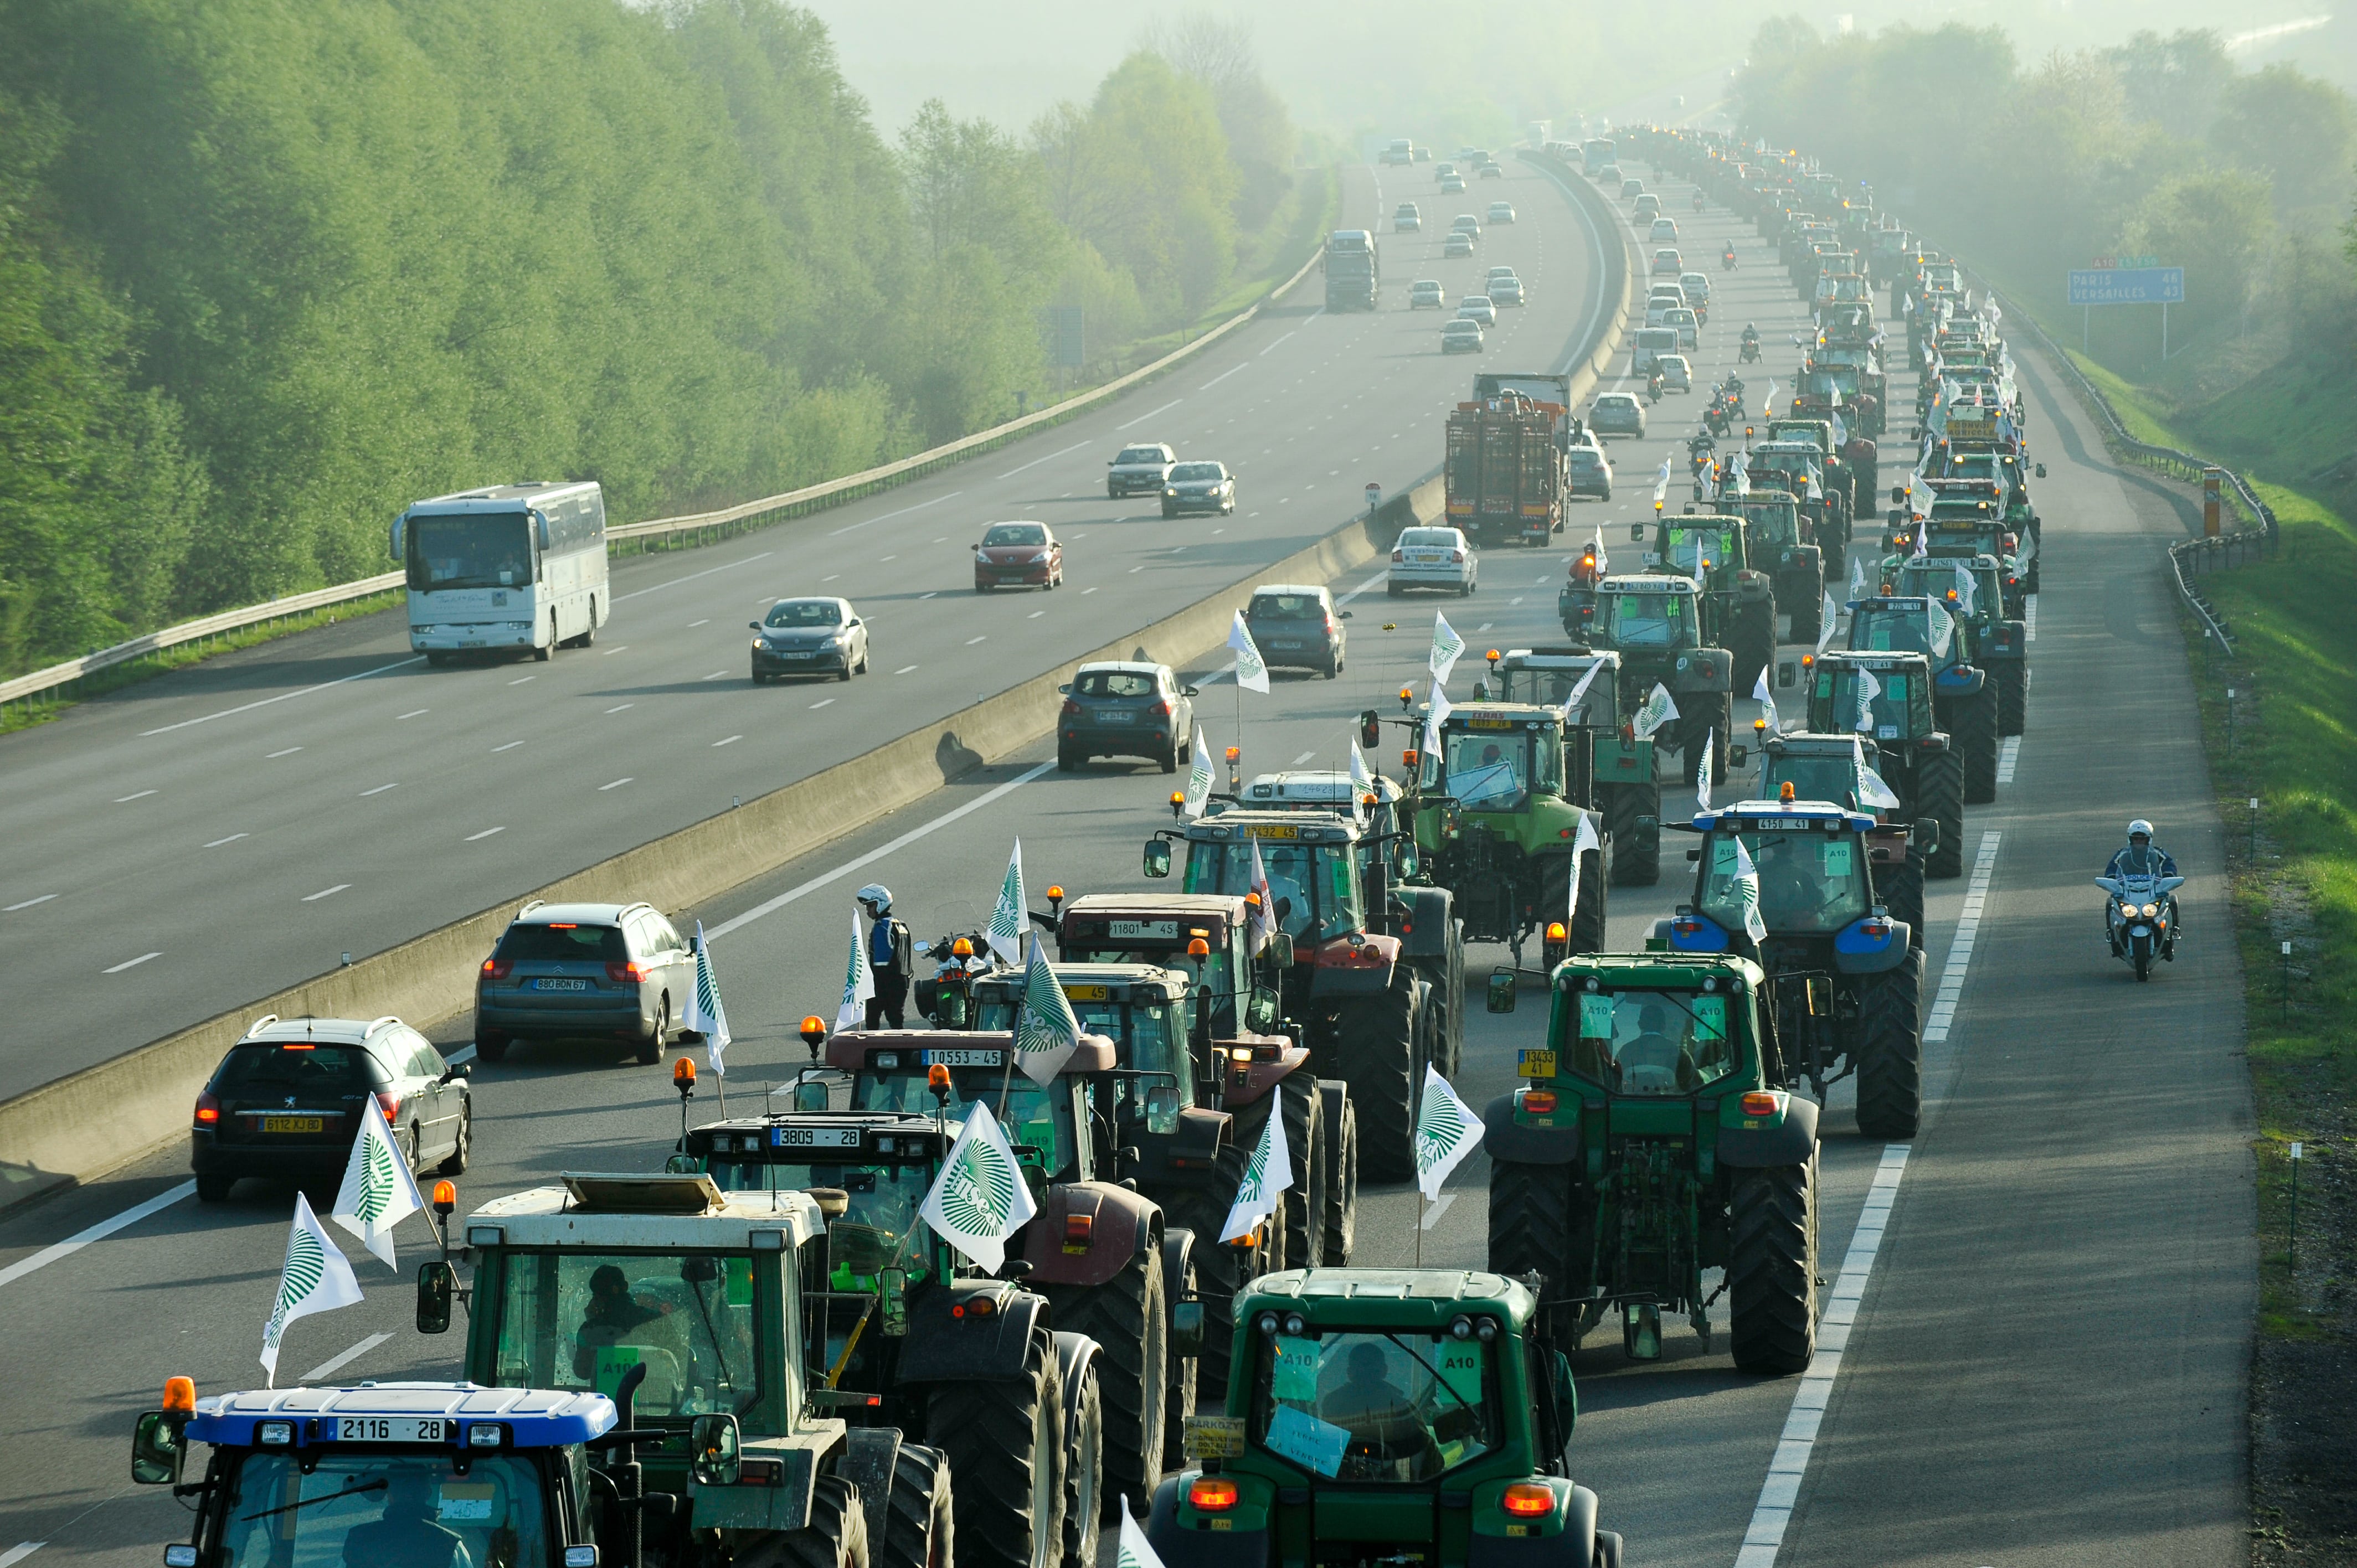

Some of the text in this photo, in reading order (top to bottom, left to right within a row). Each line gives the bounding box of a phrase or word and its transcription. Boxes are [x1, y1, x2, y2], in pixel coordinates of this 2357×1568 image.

[2094, 259, 2114, 267] A10
[2138, 257, 2157, 266] E50
[2073, 275, 2112, 286] PARIS
[2073, 287, 2146, 300] VERSAILLES
[1761, 819, 1806, 829] 4150 41
[1283, 827, 1295, 837] 45
[1113, 924, 1173, 935] 11801 45
[538, 980, 583, 989] 880 BDN 67
[1092, 987, 1105, 998] 45
[1588, 1007, 1608, 1015] A10
[931, 1051, 970, 1064] 10553
[984, 1052, 998, 1064] 45
[1526, 1051, 1553, 1062] 13433
[1531, 1062, 1542, 1074] 41
[267, 1120, 290, 1129] 6112
[295, 1120, 305, 1129] XJ
[781, 1130, 813, 1144] 3809
[841, 1132, 857, 1145] 28
[1026, 1136, 1049, 1145] A19
[1284, 1353, 1312, 1366] A10
[1445, 1357, 1474, 1369] A10
[603, 1363, 631, 1374] A10
[343, 1420, 389, 1438] 2116
[418, 1421, 440, 1439] 28
